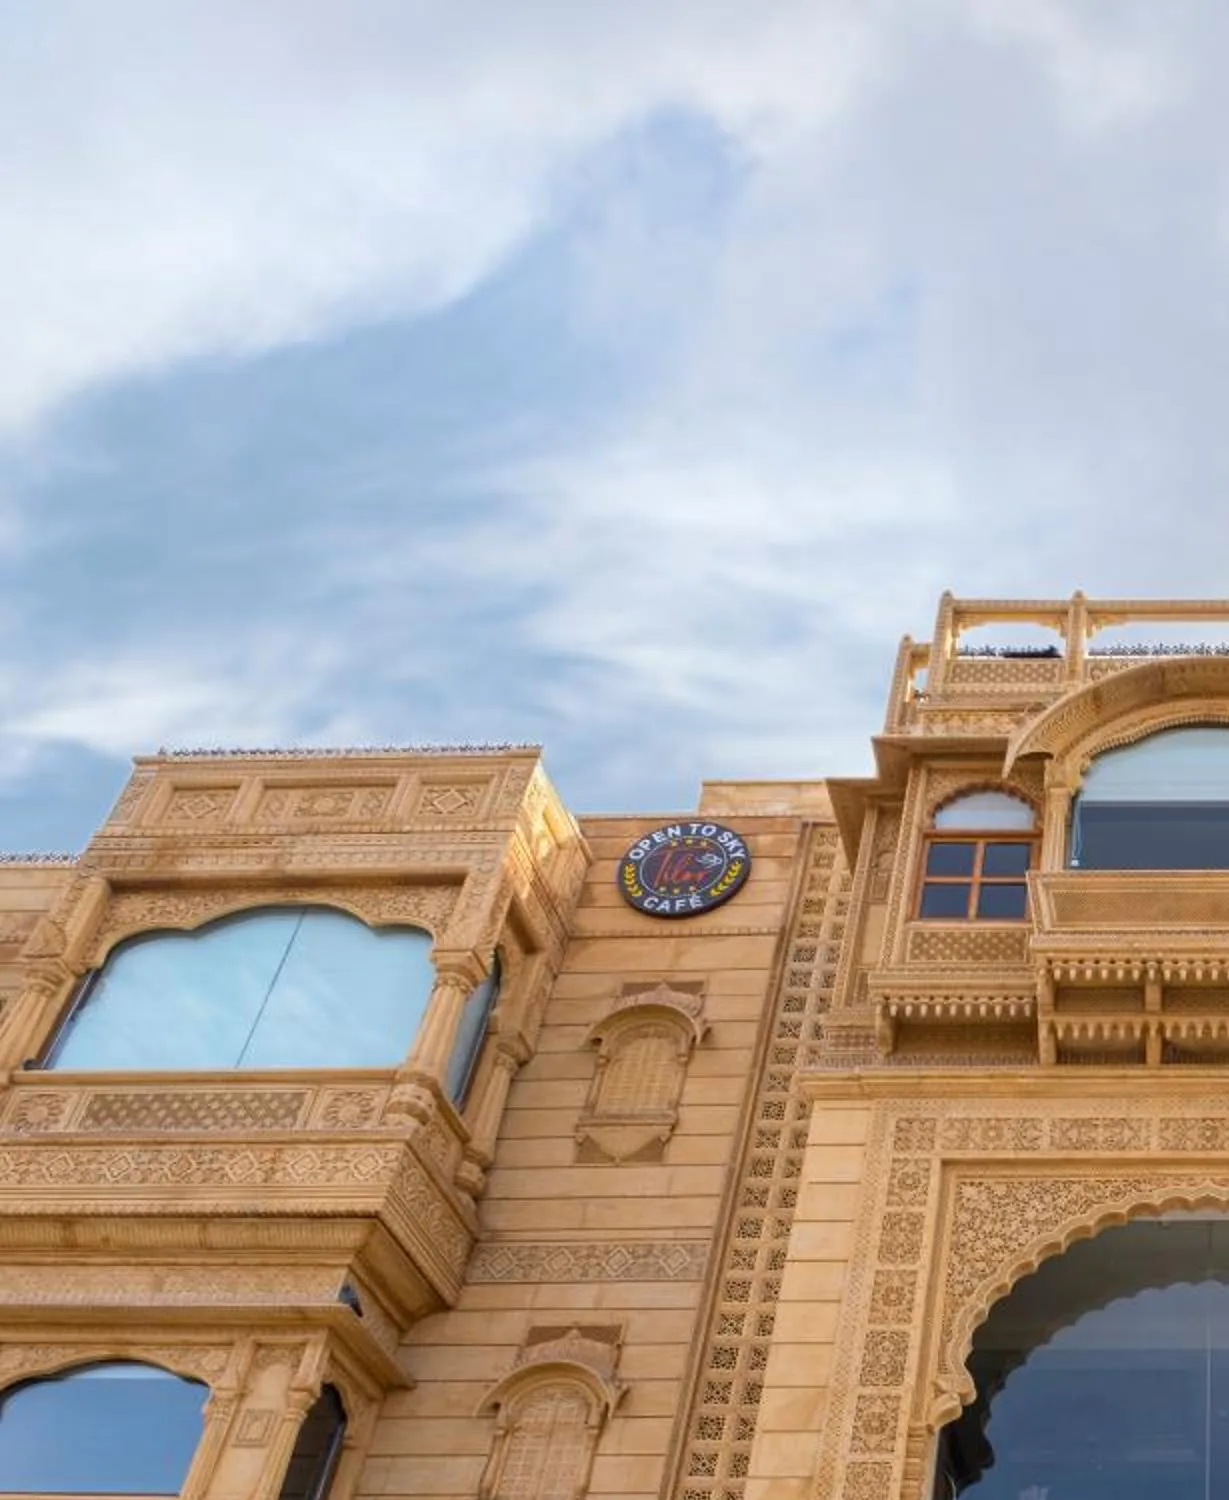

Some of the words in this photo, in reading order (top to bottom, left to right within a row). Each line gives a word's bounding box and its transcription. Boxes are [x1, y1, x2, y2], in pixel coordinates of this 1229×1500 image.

[628, 825, 682, 860] OPEN
[689, 823, 717, 837] TO
[717, 831, 747, 859] SKY
